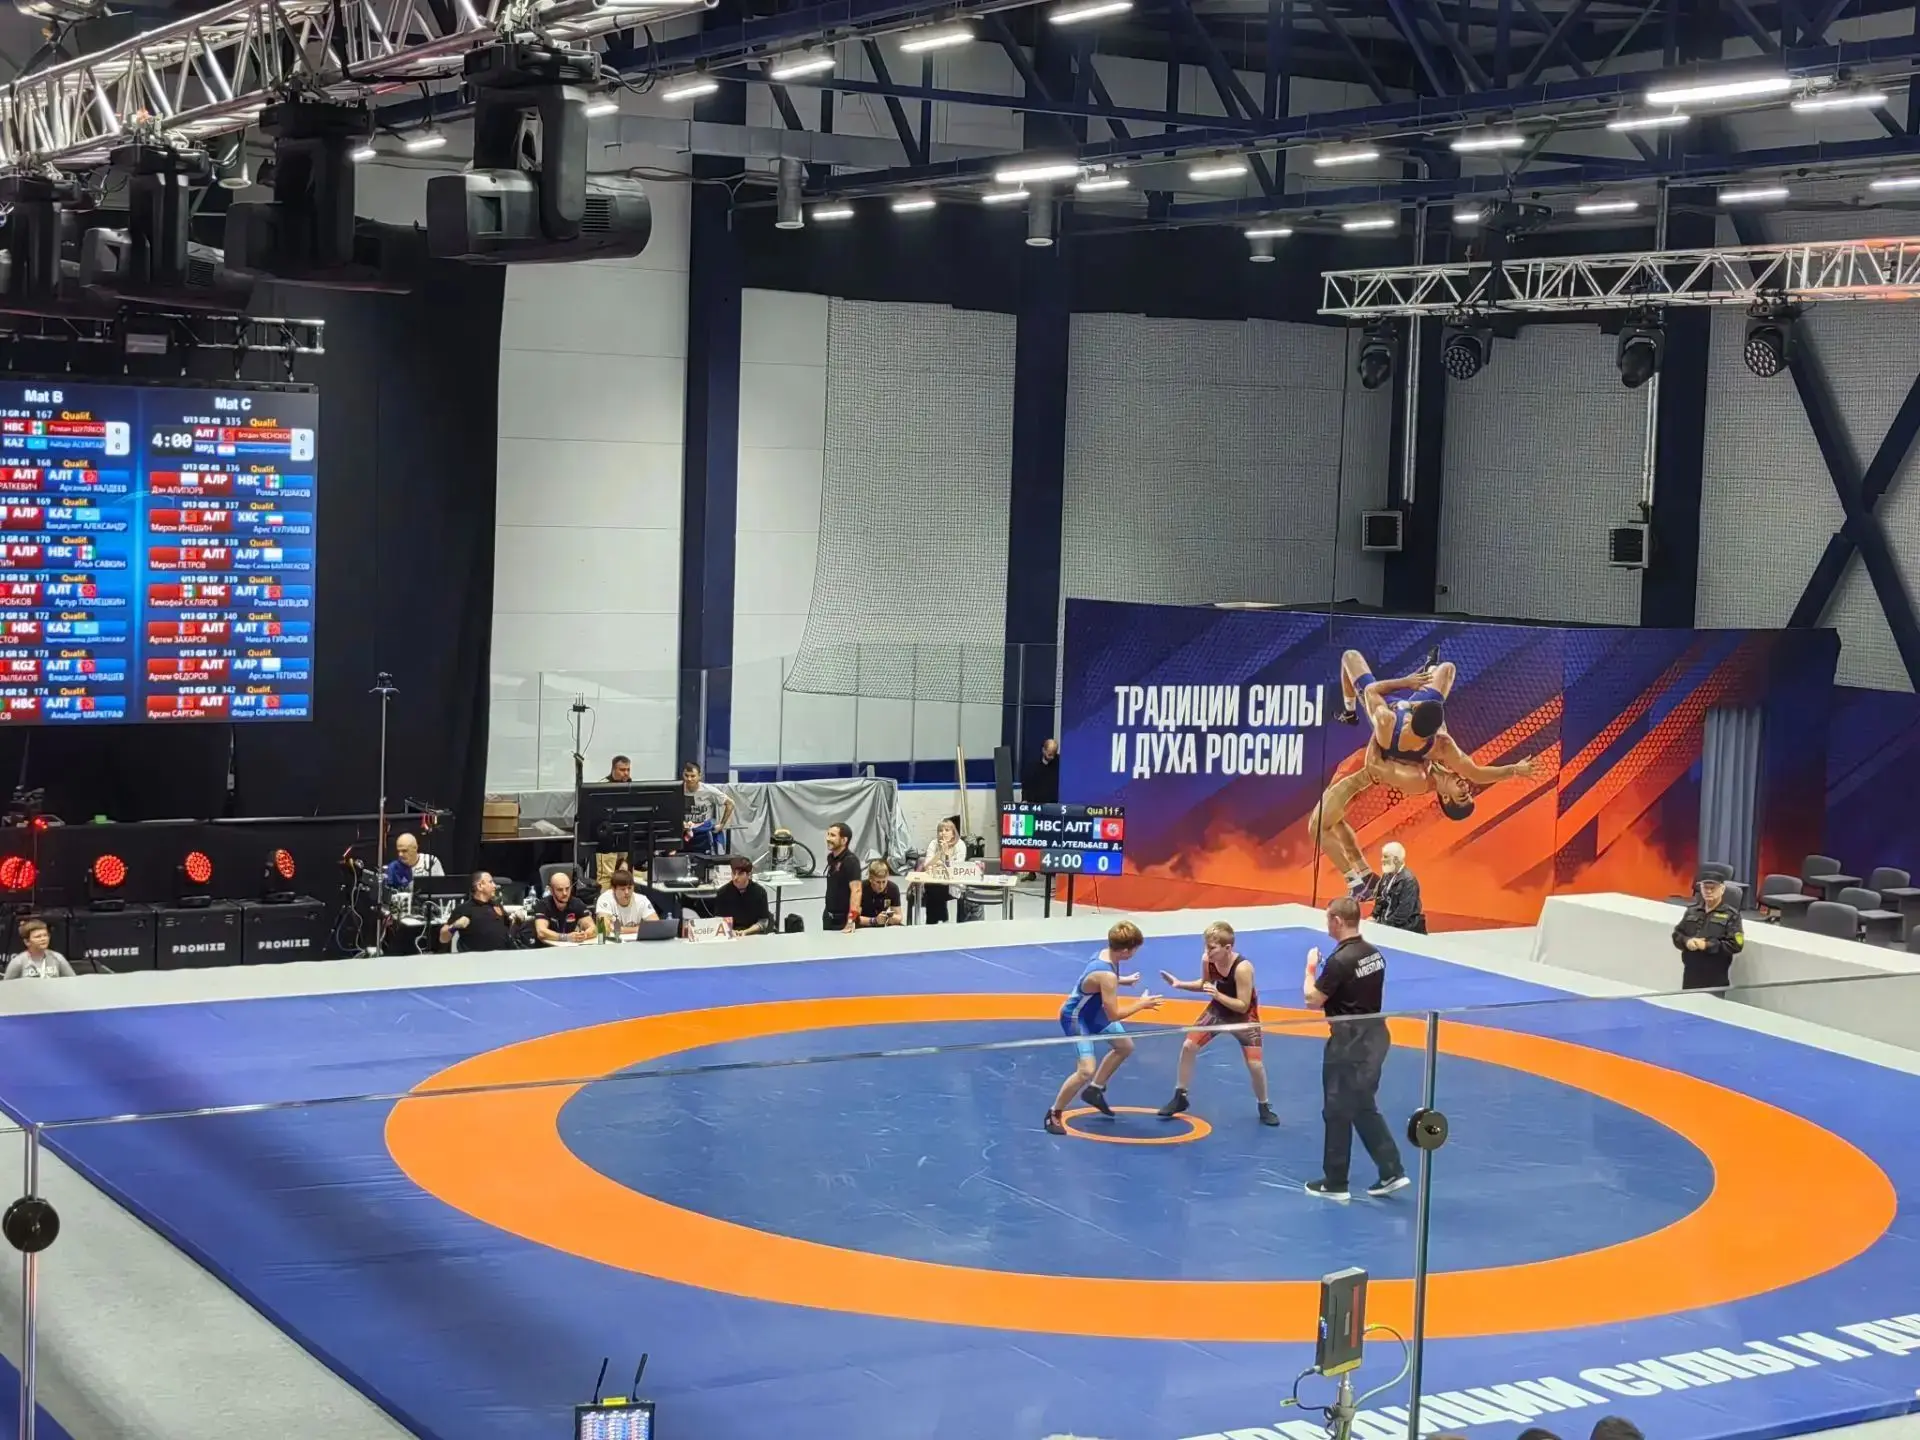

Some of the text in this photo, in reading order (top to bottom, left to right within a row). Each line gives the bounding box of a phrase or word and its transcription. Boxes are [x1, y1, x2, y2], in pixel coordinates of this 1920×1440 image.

[25, 390, 64, 403] Mat B
[215, 397, 252, 410] Mat C
[61, 412, 92, 420] Qualif.
[226, 417, 241, 425] 335
[250, 418, 277, 427] Qualif.
[195, 429, 215, 438] АЛТ
[152, 432, 193, 448] 4:00
[13, 470, 38, 480] АЛТ
[48, 470, 73, 480] АЛТ
[204, 475, 228, 484] АЛР
[63, 498, 88, 506] Qualif.
[250, 502, 275, 510] Qualif.
[13, 508, 39, 518] АЛР
[48, 508, 72, 518] KAZ
[204, 512, 227, 522] АЛТ
[12, 546, 38, 556] АЛР
[202, 549, 226, 559] АЛТ
[236, 549, 259, 559] АЛР
[12, 584, 37, 594] АЛТ
[47, 585, 72, 594] АЛТ
[235, 586, 257, 596] АЛТ
[47, 623, 70, 632] KAZ
[201, 623, 225, 632] АЛТ
[234, 623, 257, 632] АЛТ
[12, 661, 36, 670] KGZ
[46, 661, 70, 670] АЛТ
[200, 660, 224, 670] АЛТ
[233, 660, 257, 669] АЛР
[46, 699, 70, 708] АЛТ
[200, 697, 224, 706] АЛТ
[233, 696, 256, 706] АЛТ
[1114, 684, 1324, 732] ТРАДИЦИИ СИЛЫ
[1111, 733, 1304, 779] И ДУХА РОССИИ
[1061, 806, 1067, 814] 5
[1087, 806, 1123, 816] Qualif.
[1035, 820, 1061, 832] НВС
[1065, 821, 1092, 833] АЛТ
[1062, 841, 1108, 849] УТЕЛЬБАЕВ
[1014, 852, 1025, 868] 0
[1042, 853, 1082, 869] 4:00
[1098, 856, 1109, 872] 0
[953, 867, 976, 876] ВРАЧ
[715, 923, 726, 937] А
[1579, 1340, 1821, 1396] СИЛЫ
[1777, 1331, 1873, 1362] И
